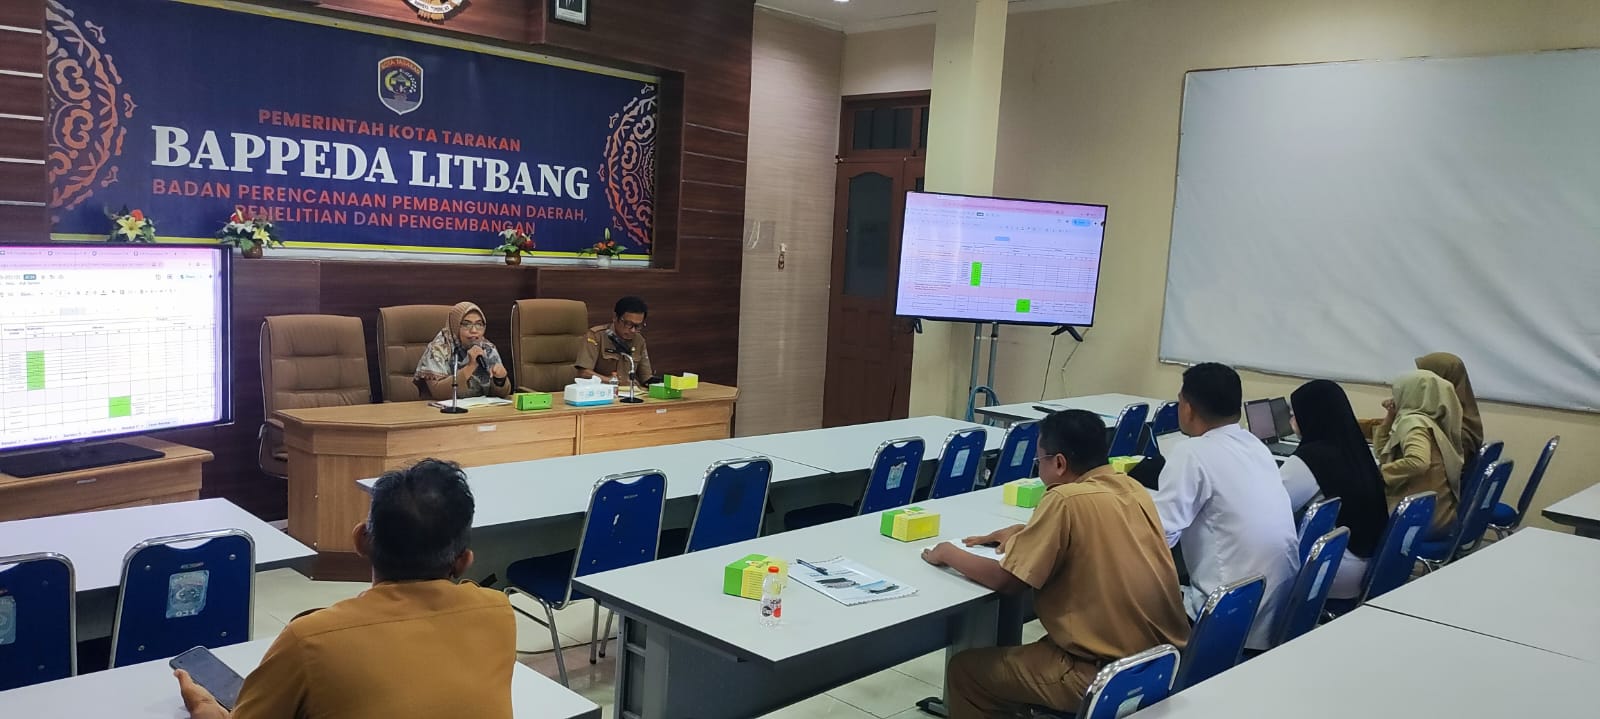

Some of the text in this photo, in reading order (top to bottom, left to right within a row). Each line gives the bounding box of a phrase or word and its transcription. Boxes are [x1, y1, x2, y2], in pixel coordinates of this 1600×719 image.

[258, 109, 521, 152] PEMERINTAH KOTA TARAKAN
[151, 125, 590, 200] BAPPEDA LITBANG
[152, 178, 588, 223] BADAN PERENCANAAN PEMBANGUNAN DAERAH,
[354, 211, 393, 227] DAN
[399, 215, 536, 234] PENGEMBANGAN
